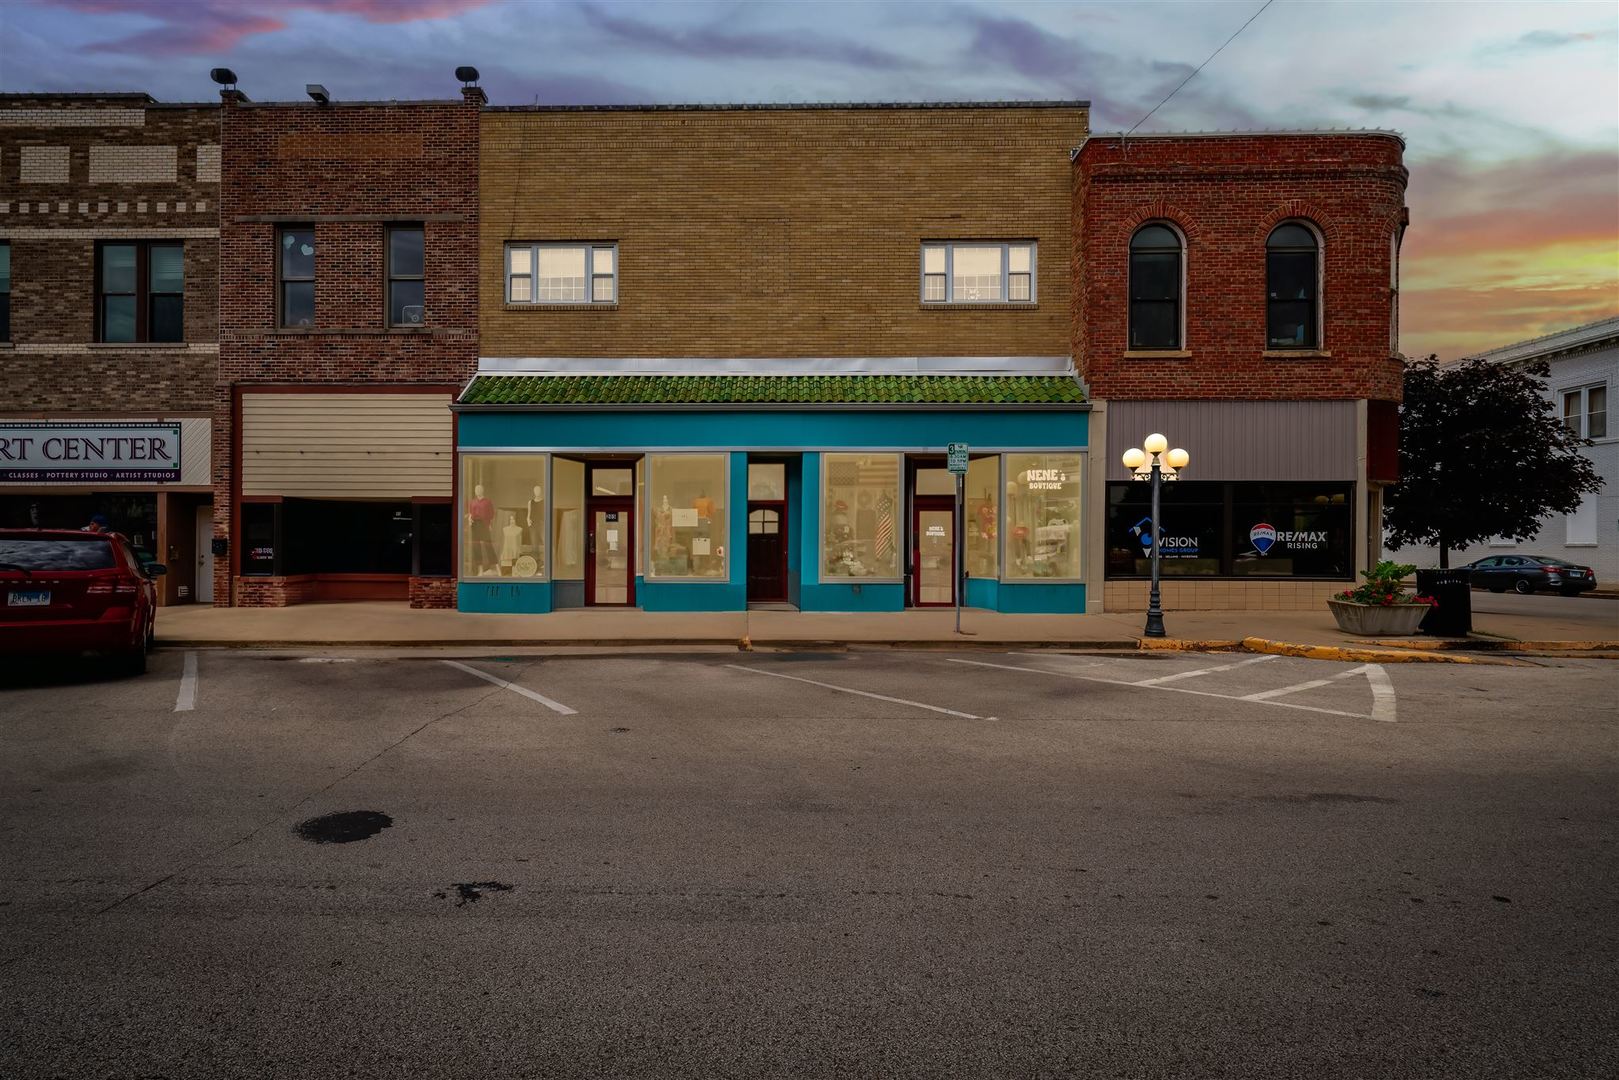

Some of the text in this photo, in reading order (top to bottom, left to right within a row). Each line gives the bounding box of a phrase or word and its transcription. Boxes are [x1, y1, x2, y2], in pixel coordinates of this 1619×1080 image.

[42, 437, 172, 461] CENTER
[949, 445, 954, 454] 3
[1158, 536, 1198, 547] VISION
[1276, 531, 1326, 542] RE/MAX
